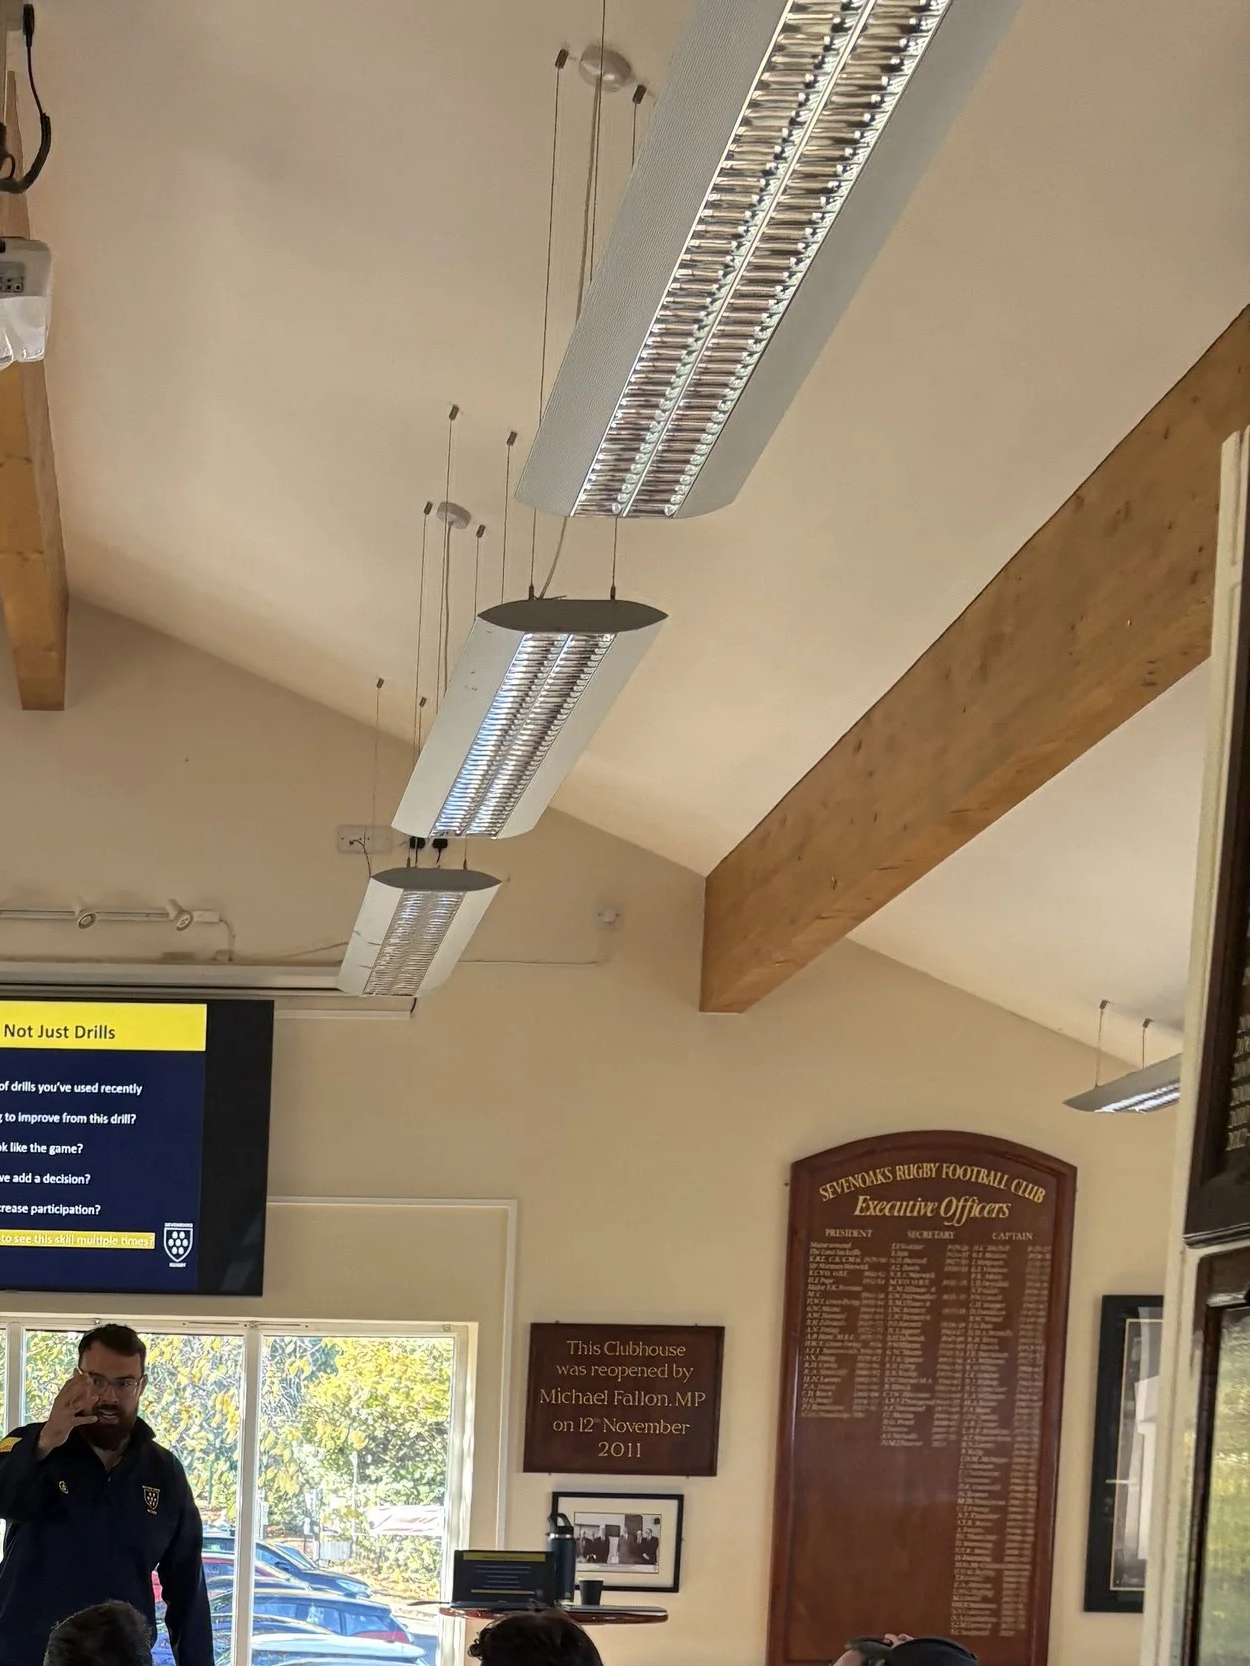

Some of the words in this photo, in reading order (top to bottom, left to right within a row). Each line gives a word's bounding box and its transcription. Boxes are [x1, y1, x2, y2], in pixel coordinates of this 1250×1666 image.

[4, 1024, 33, 1038] Not
[38, 1025, 69, 1039] Just
[75, 1025, 116, 1039] Drills
[11, 1081, 36, 1092] drills
[38, 1082, 71, 1095] you've
[74, 1083, 98, 1093] used
[101, 1083, 143, 1096] recently
[5, 1112, 16, 1122] to
[18, 1111, 60, 1124] improve
[62, 1112, 87, 1123] from
[89, 1113, 108, 1124] this
[110, 1113, 137, 1125] drill?
[10, 1142, 27, 1153] like
[29, 1143, 47, 1154] the
[49, 1143, 83, 1155] game?
[12, 1173, 32, 1183] add
[34, 1175, 41, 1184] a
[43, 1173, 91, 1185] decision?
[819, 1166, 892, 1202] SEVENOAKS
[896, 1162, 941, 1181] RUGBY
[942, 1163, 1013, 1190] FOOTBALL
[1010, 1178, 1046, 1204] CLUB
[30, 1203, 101, 1216] participation?
[854, 1195, 938, 1216] Executive
[939, 1195, 1011, 1226] Officers
[1, 1234, 11, 1244] to
[13, 1235, 31, 1244] see
[34, 1233, 52, 1245] this
[54, 1234, 74, 1245] skill
[76, 1235, 118, 1247] multiple
[121, 1236, 154, 1247] times?
[825, 1228, 873, 1238] PRESIDENT
[907, 1230, 956, 1240] SECRETARY
[992, 1231, 1034, 1241] CAPTAIN
[566, 1340, 601, 1355] This
[603, 1341, 686, 1356] Clubhouse
[556, 1364, 587, 1376] was
[591, 1364, 668, 1382] reopened
[673, 1363, 694, 1383] by
[540, 1388, 608, 1405] Michael
[675, 1391, 706, 1407] MP
[553, 1420, 574, 1432] on
[603, 1417, 691, 1435] November
[598, 1441, 642, 1458] 2011
